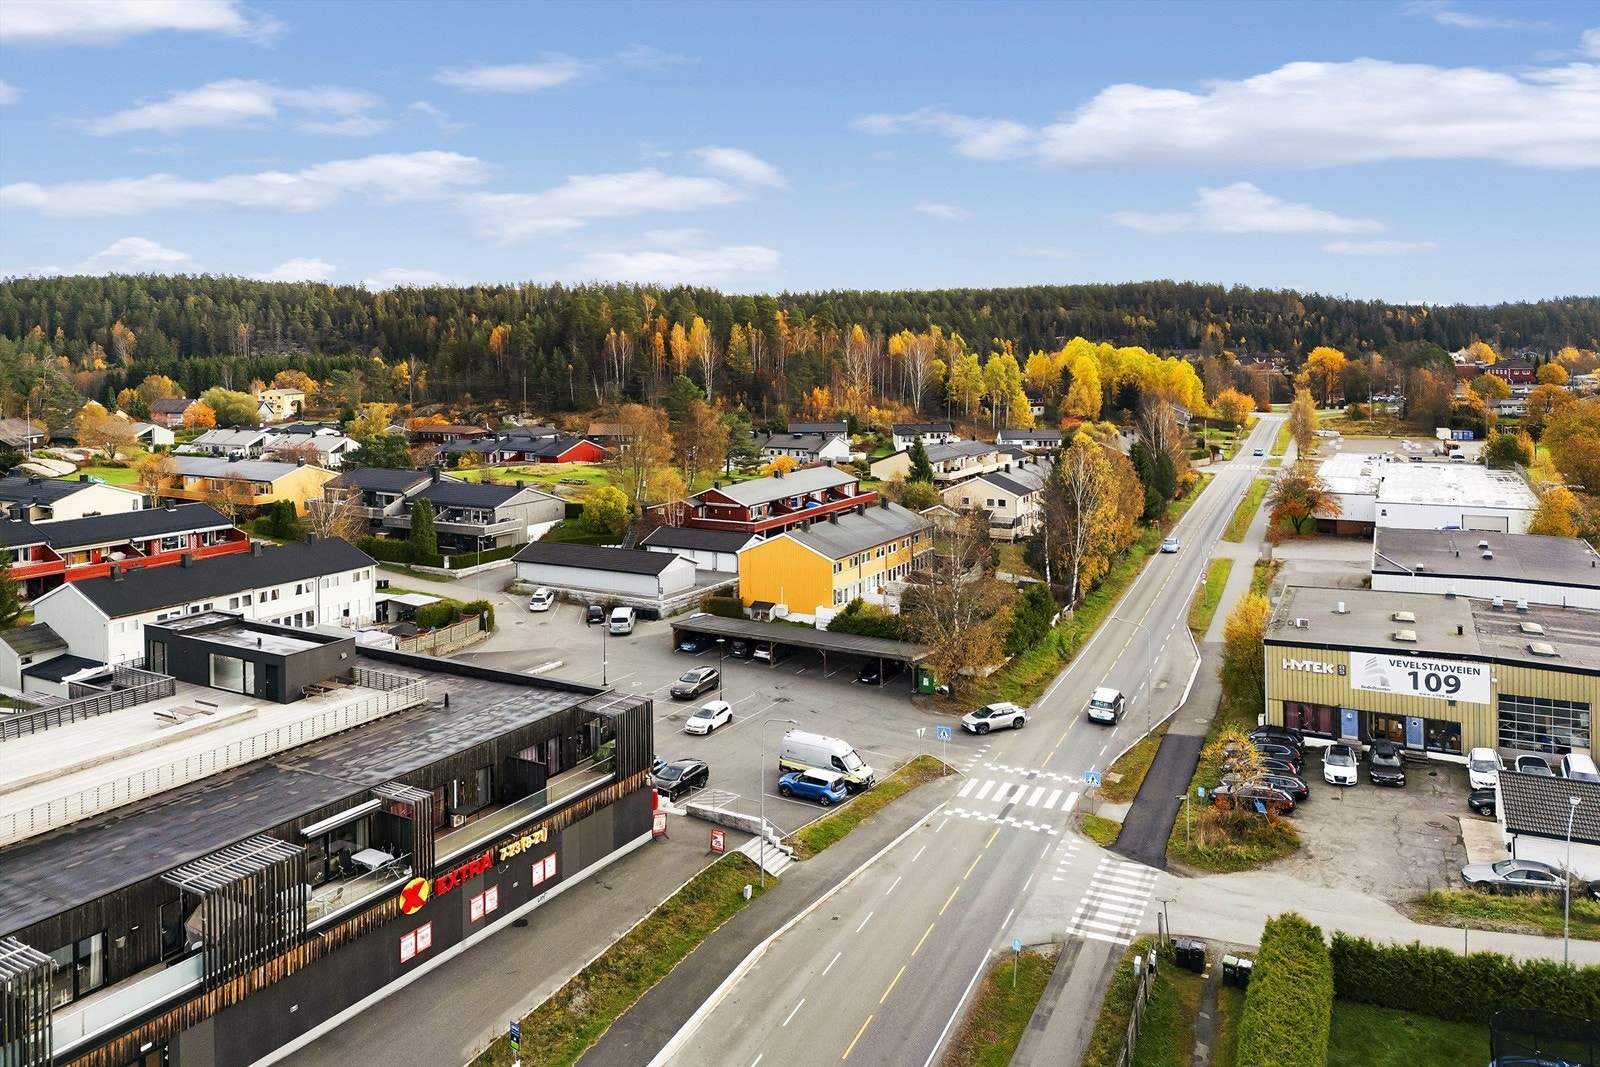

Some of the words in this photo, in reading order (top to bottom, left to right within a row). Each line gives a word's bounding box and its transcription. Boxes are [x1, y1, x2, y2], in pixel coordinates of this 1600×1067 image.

[1282, 658, 1334, 674] HYTEK
[1389, 659, 1481, 676] VEVELSTADVEIEN
[1408, 671, 1461, 694] 109
[435, 853, 493, 896] EXTRA
